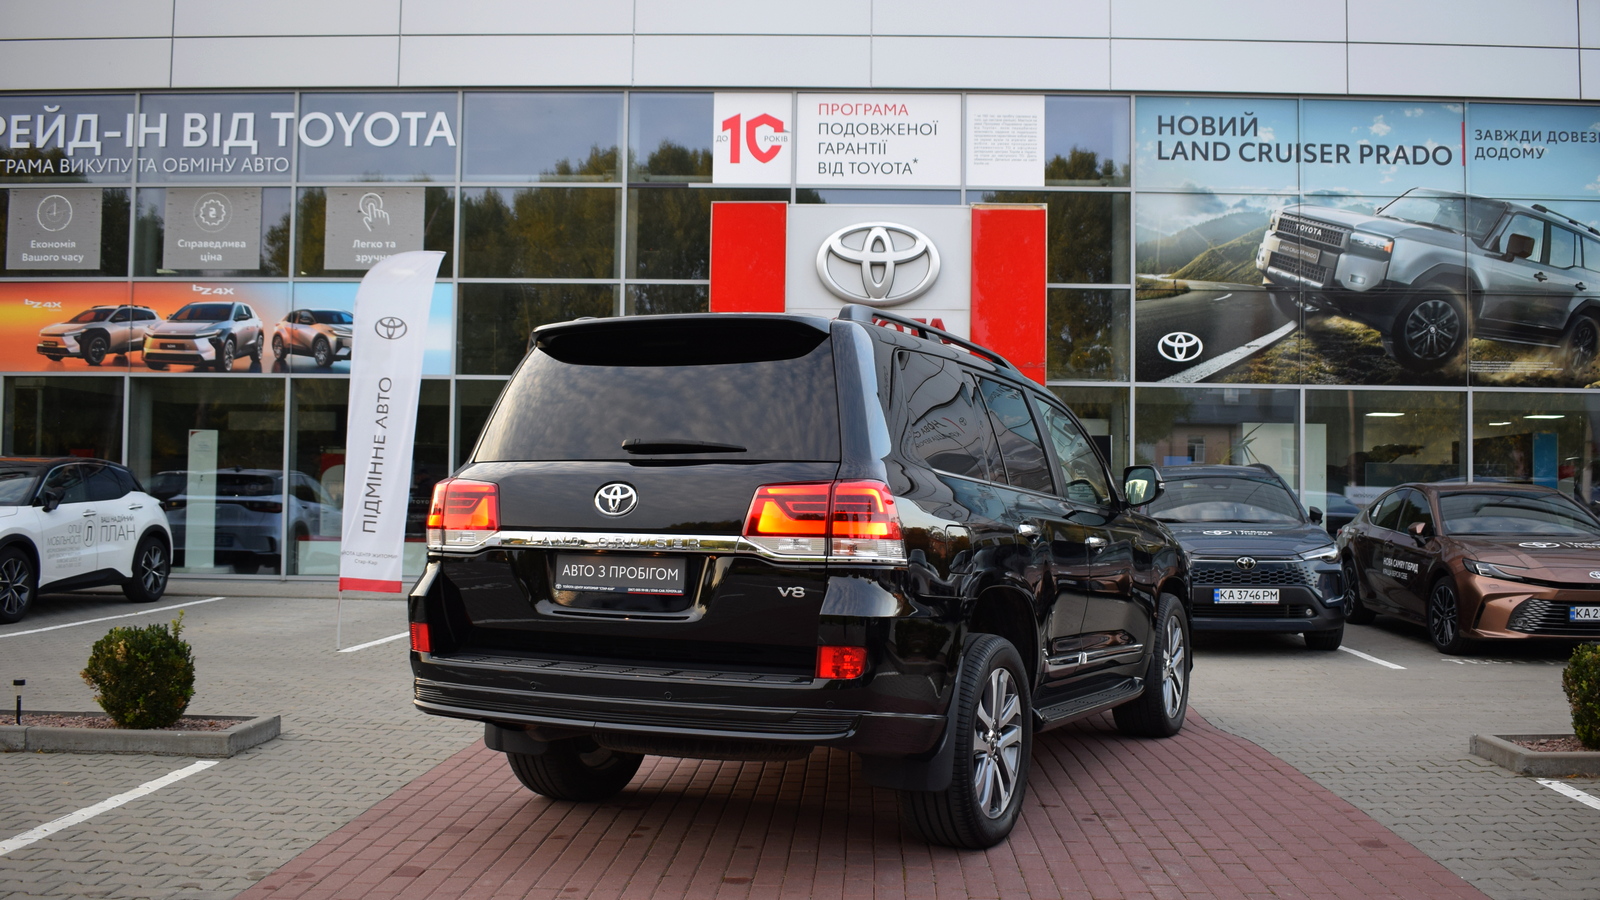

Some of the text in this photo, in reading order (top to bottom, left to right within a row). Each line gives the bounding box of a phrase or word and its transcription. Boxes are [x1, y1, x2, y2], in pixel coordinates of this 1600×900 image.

[818, 103, 909, 116] ПРОГРАМА
[818, 120, 939, 138] ПОДОВЖЕНОЇ
[1157, 112, 1259, 138] НОВИЙ
[183, 112, 259, 155] ВІД
[270, 111, 456, 148] TOYOTA
[1475, 129, 1542, 144] ЗАВЖДИ
[818, 139, 888, 155] ГАРАНТІЇ
[1475, 147, 1545, 160] ДОДОМУ
[1157, 142, 1453, 166] LAND CRUISER PRADO
[60, 158, 132, 173] ВИКУПУ
[138, 157, 157, 173] ТА
[163, 157, 236, 173] ОБМІНУ
[241, 157, 289, 173] АВТО
[818, 162, 844, 177] ВІД
[1295, 223, 1322, 236] TOYOTA
[30, 239, 76, 248] Економія
[177, 239, 246, 250] Справедлива
[352, 240, 383, 248] Легко
[22, 253, 84, 263] Вашого часу
[200, 252, 222, 262] ціна
[355, 254, 393, 264] зручн
[362, 376, 393, 533] ПІДМІННЕ АВТО
[100, 525, 136, 542] ПЛАН
[598, 536, 701, 549] CRUISER
[562, 564, 595, 577] АВТО
[609, 566, 679, 580] ПРОБІГОМ
[777, 586, 805, 598] V8
[1220, 590, 1278, 600] KA 3746 PM
[1575, 608, 1591, 619] KA
